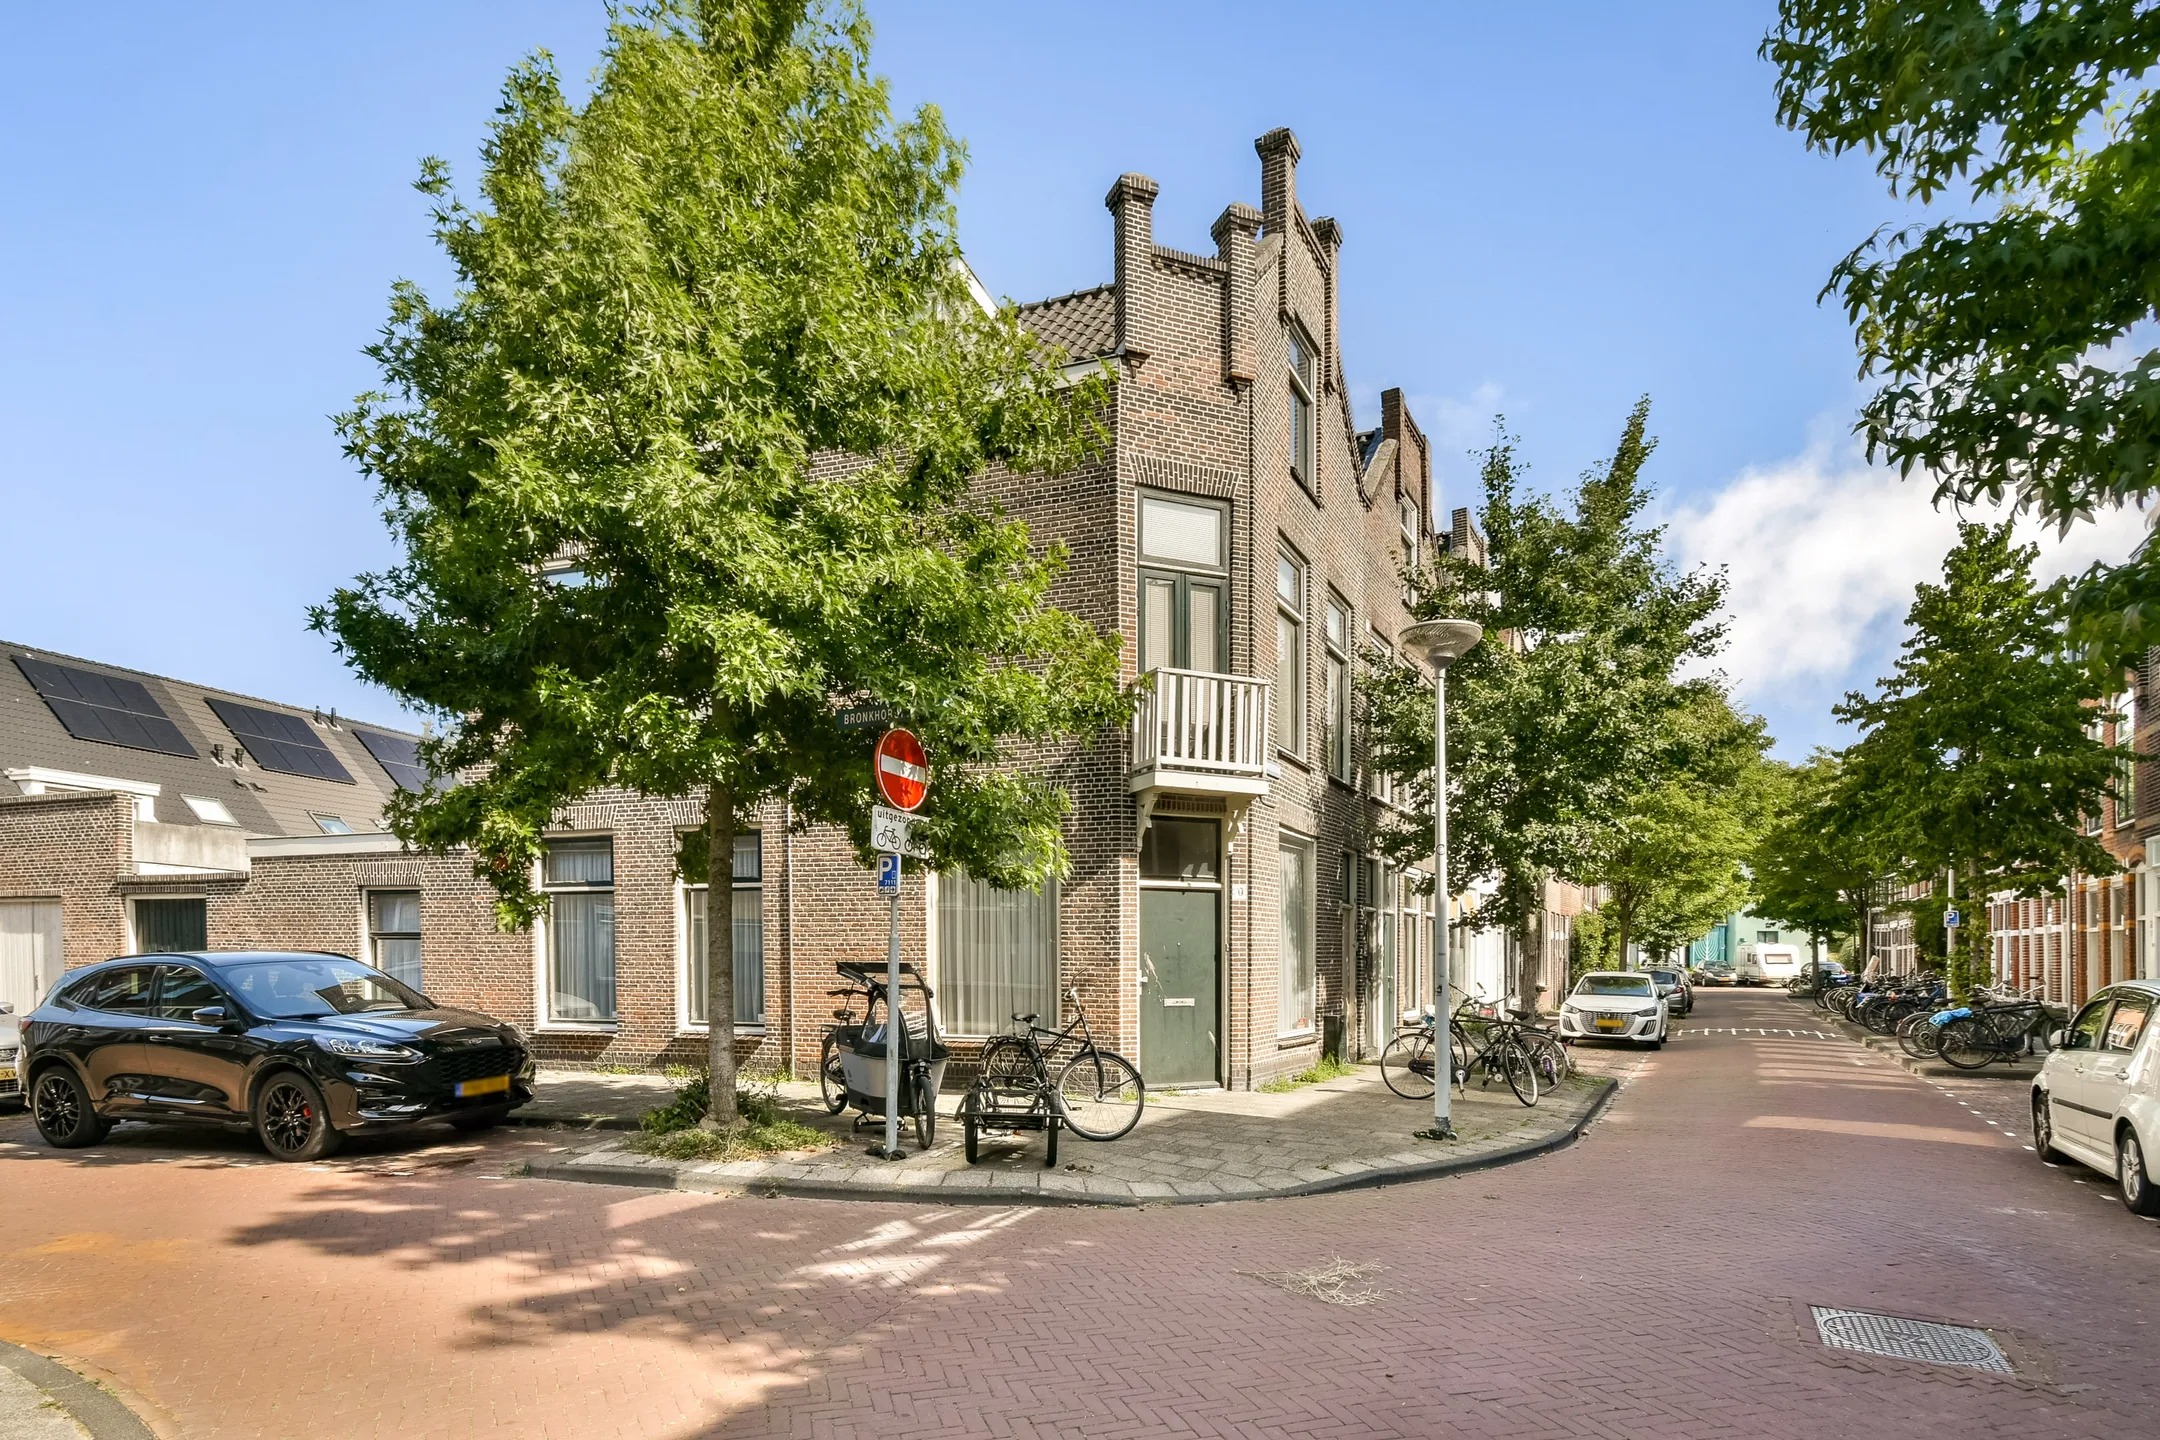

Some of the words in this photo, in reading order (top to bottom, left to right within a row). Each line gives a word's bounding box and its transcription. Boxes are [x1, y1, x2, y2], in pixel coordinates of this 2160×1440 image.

[844, 708, 903, 725] BRONKHOR
[877, 810, 915, 823] uitgezon
[880, 857, 892, 880] P
[1946, 912, 1955, 922] P
